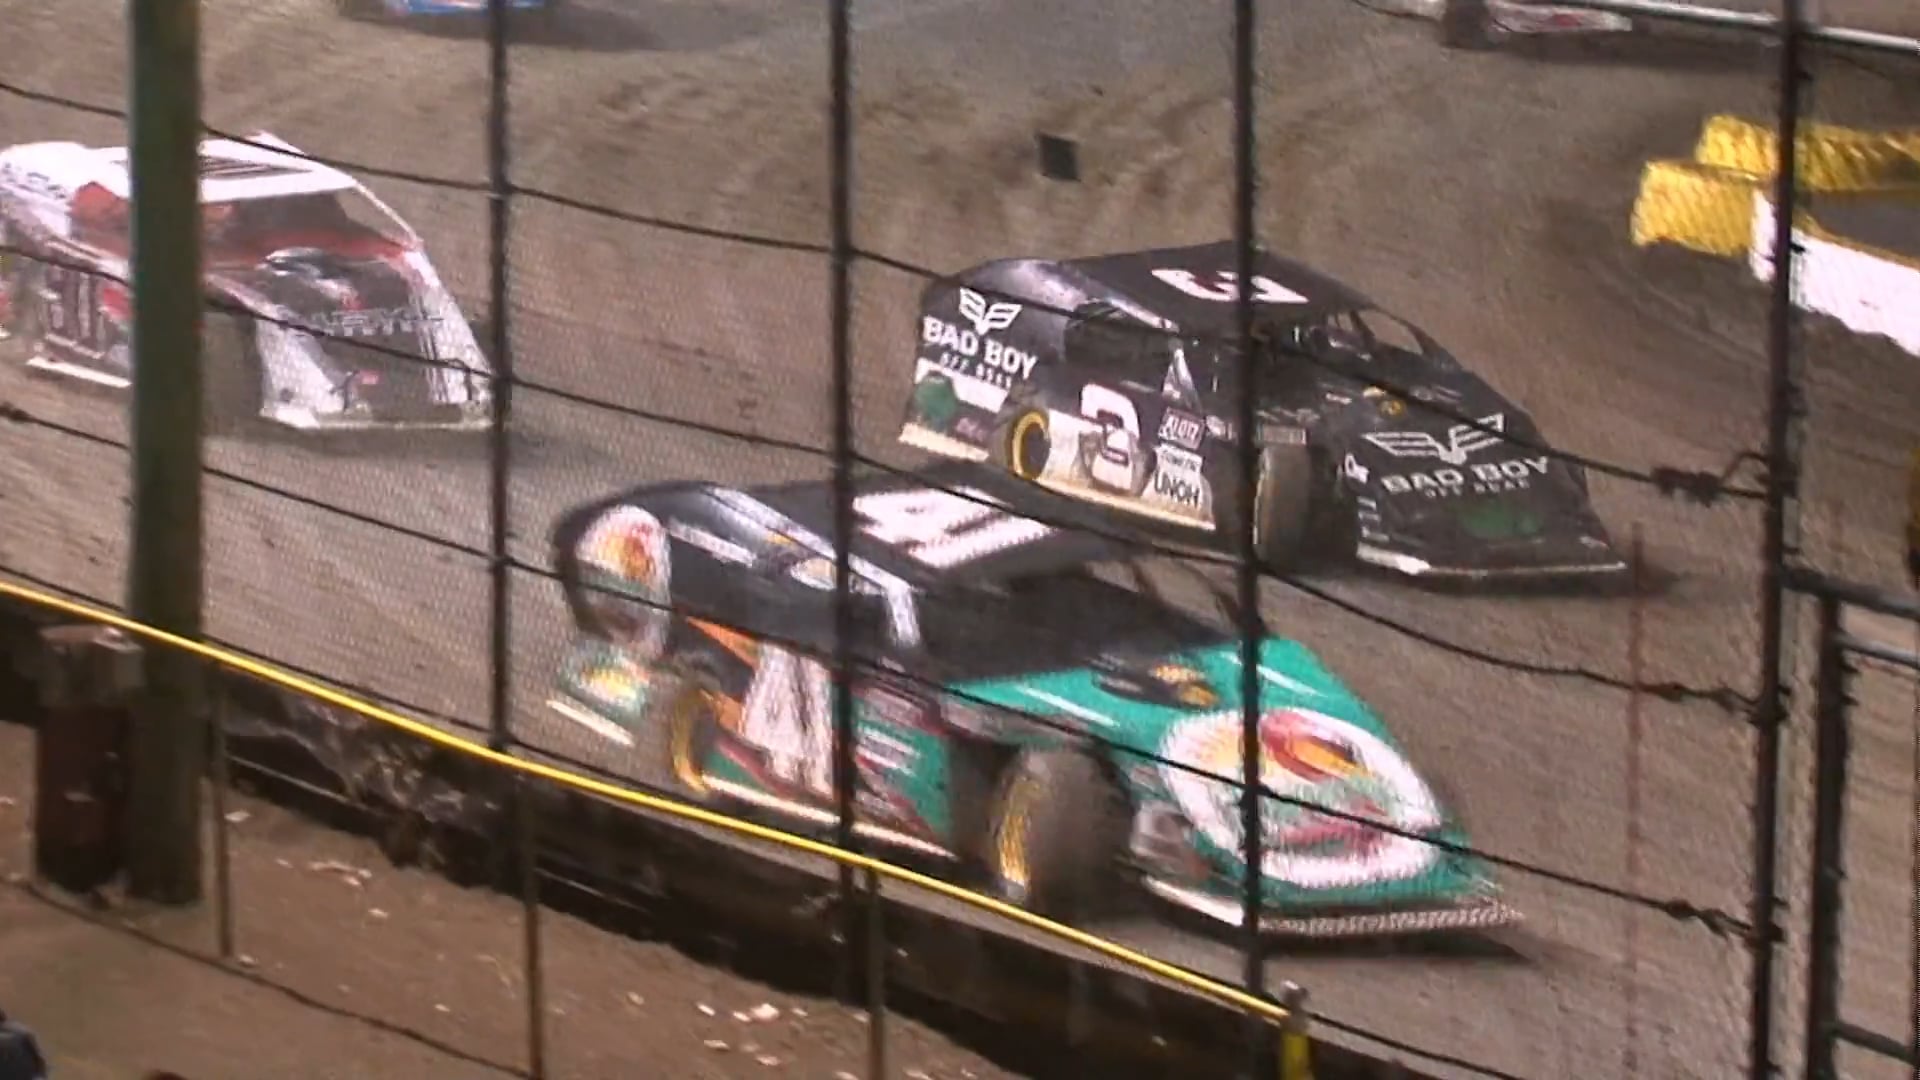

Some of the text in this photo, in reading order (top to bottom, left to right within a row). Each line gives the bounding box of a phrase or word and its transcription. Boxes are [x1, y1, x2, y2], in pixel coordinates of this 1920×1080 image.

[923, 314, 1038, 380] BAD BOY
[1080, 383, 1140, 492] 3
[1381, 468, 1464, 495] BAD
[1470, 456, 1548, 483] BOY
